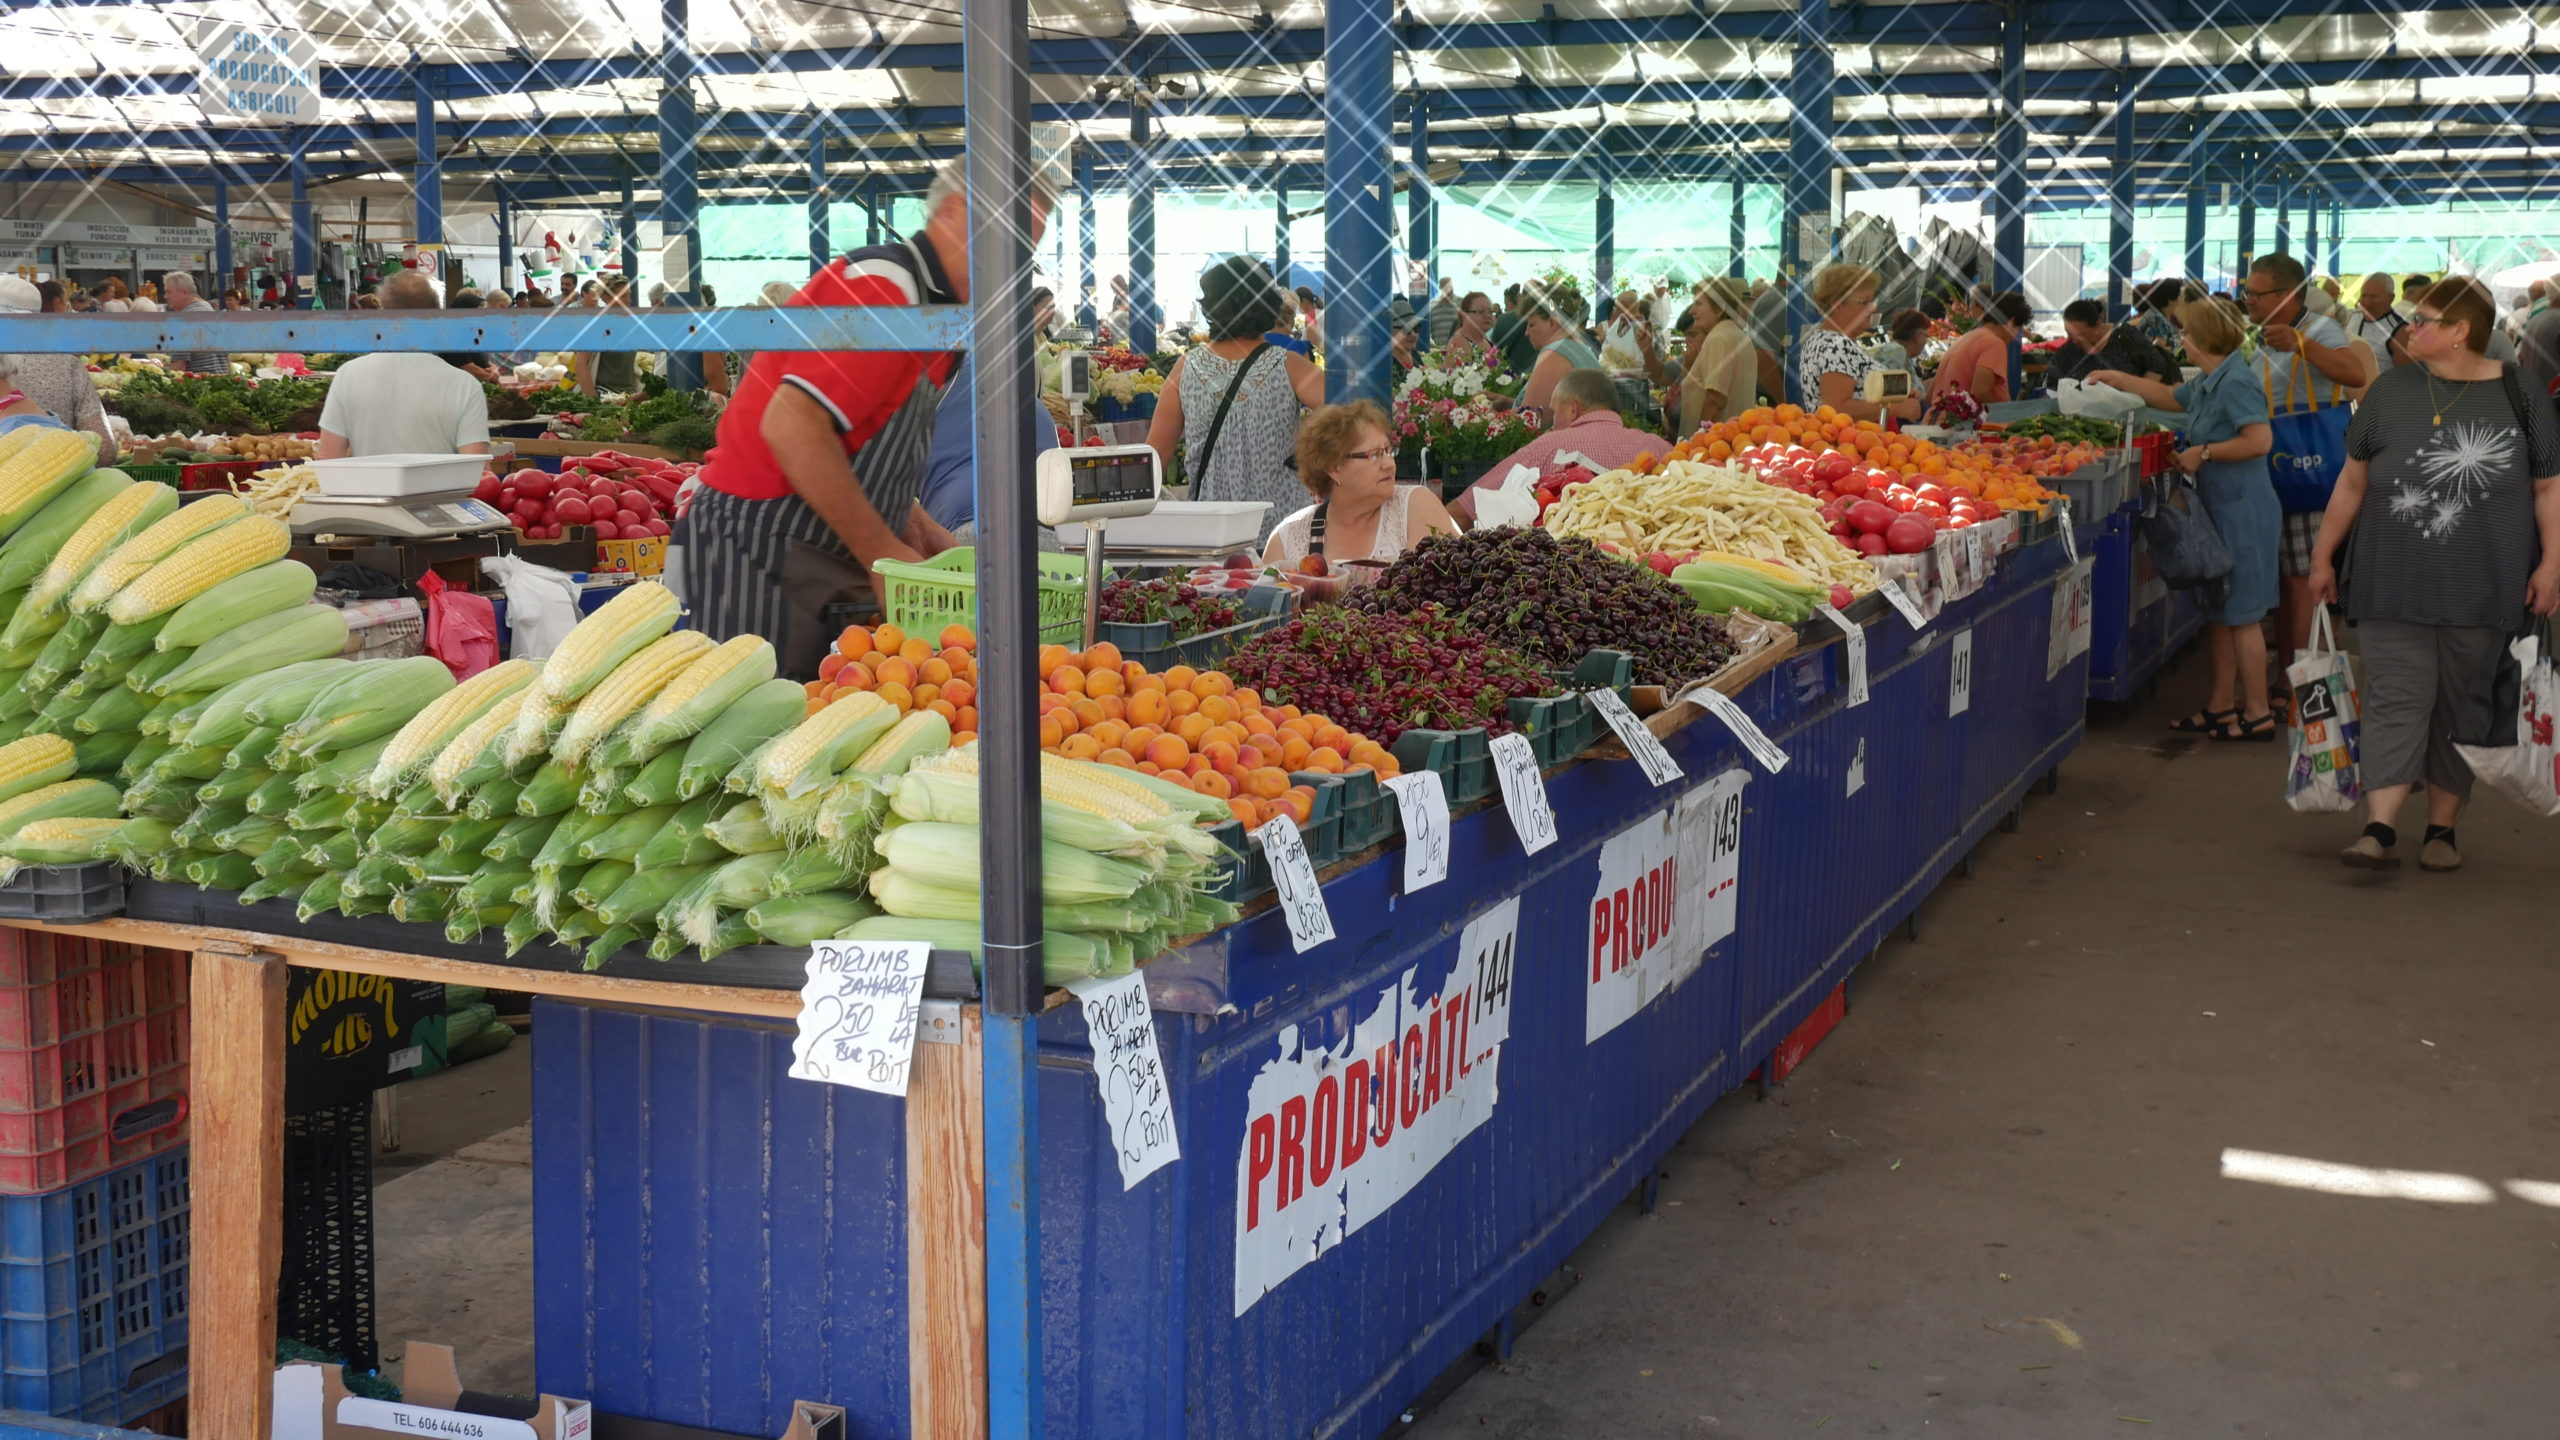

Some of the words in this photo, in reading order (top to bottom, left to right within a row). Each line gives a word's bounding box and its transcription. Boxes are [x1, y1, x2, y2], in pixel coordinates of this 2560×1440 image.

[228, 89, 297, 115] AGRICOLI
[87, 224, 130, 233] INSECTICIDE
[90, 232, 128, 241] FUNGICIDE
[2292, 454, 2323, 471] epp
[1952, 649, 1969, 697] 141
[1414, 804, 1431, 878] 9
[1712, 793, 1740, 864] 143
[819, 945, 910, 975] PORUMB
[1474, 931, 1513, 1026] 144
[842, 1002, 875, 1034] 50
[1087, 984, 1146, 1041] PORUMB
[1128, 1052, 1146, 1088] 50
[392, 1411, 417, 1428] TEL.
[418, 1416, 439, 1432] 606
[440, 1420, 462, 1436] 444
[463, 1423, 484, 1439] 636
